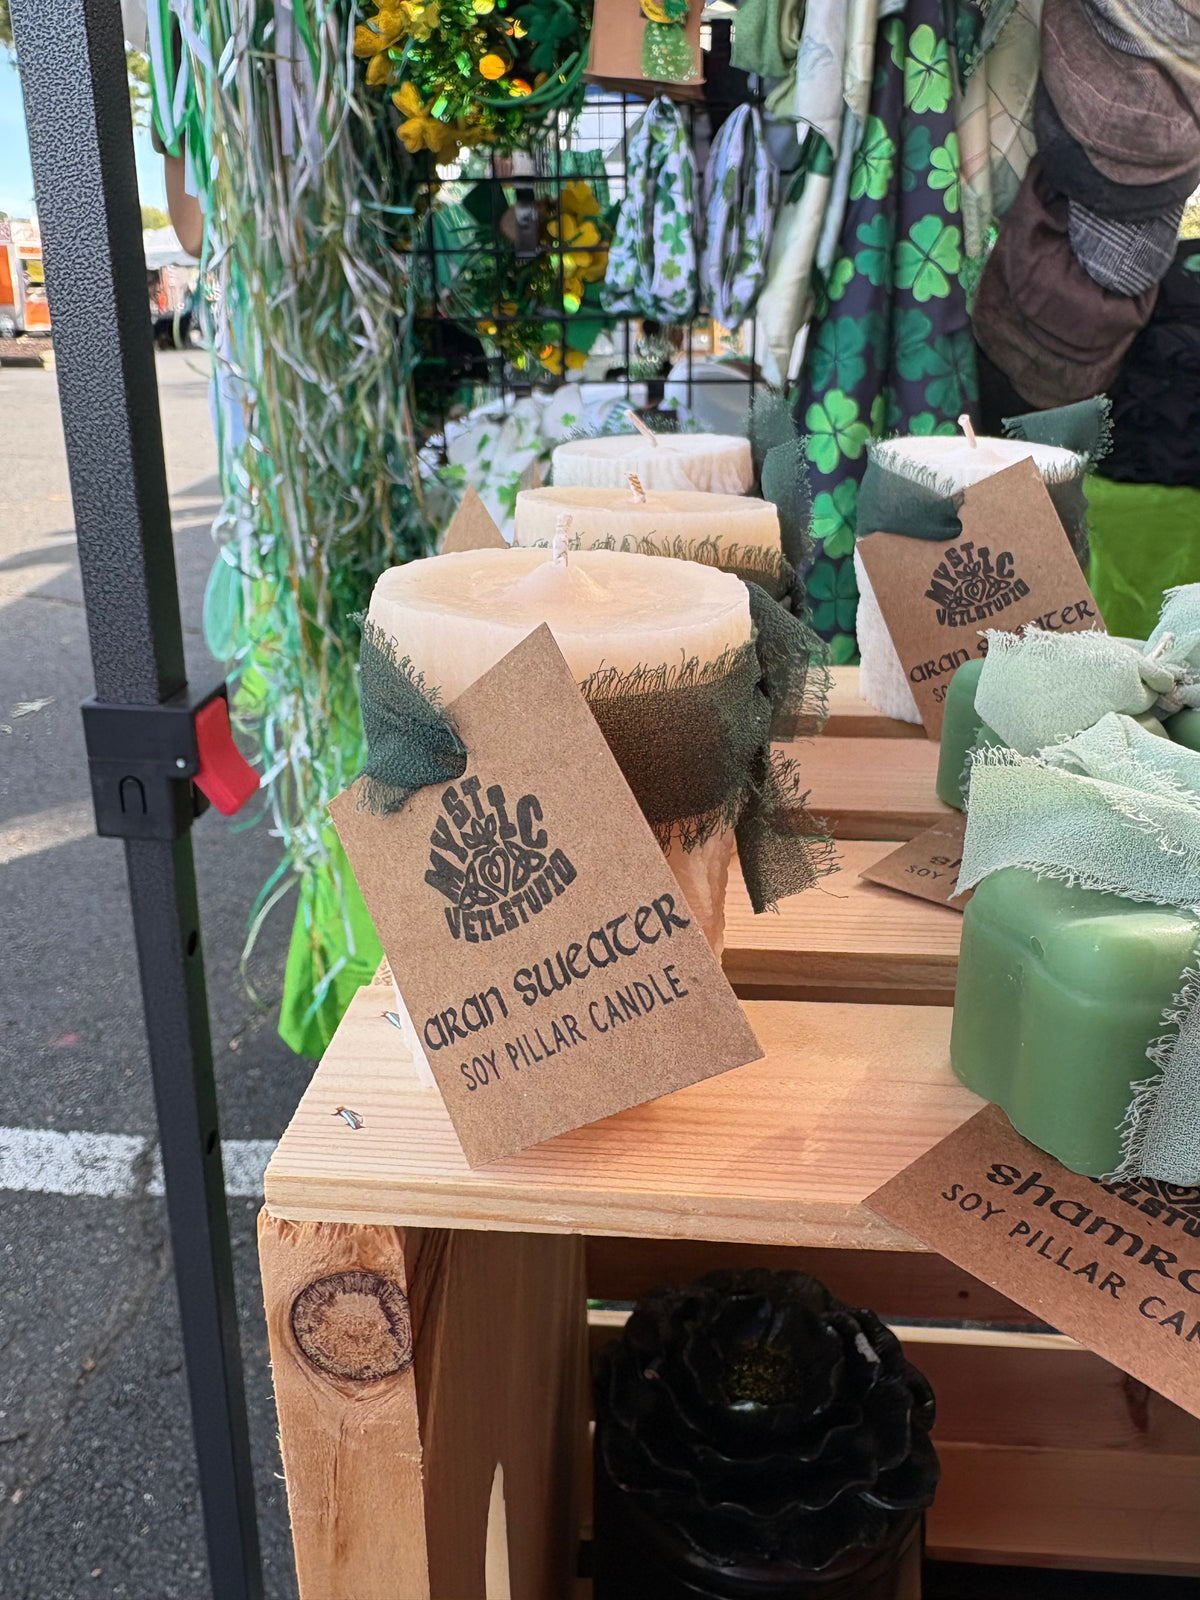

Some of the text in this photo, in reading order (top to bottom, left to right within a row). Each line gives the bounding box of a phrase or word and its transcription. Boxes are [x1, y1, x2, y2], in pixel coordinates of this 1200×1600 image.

[924, 541, 1015, 607] MYSTIC
[424, 774, 549, 905] MYSTIC
[904, 864, 944, 880] SOY
[444, 848, 578, 943] VEILSTUDIO
[460, 964, 690, 1091] SOY PILLAR CANDLE
[941, 1183, 1006, 1222] SOY
[1008, 1219, 1127, 1300] PILLAR
